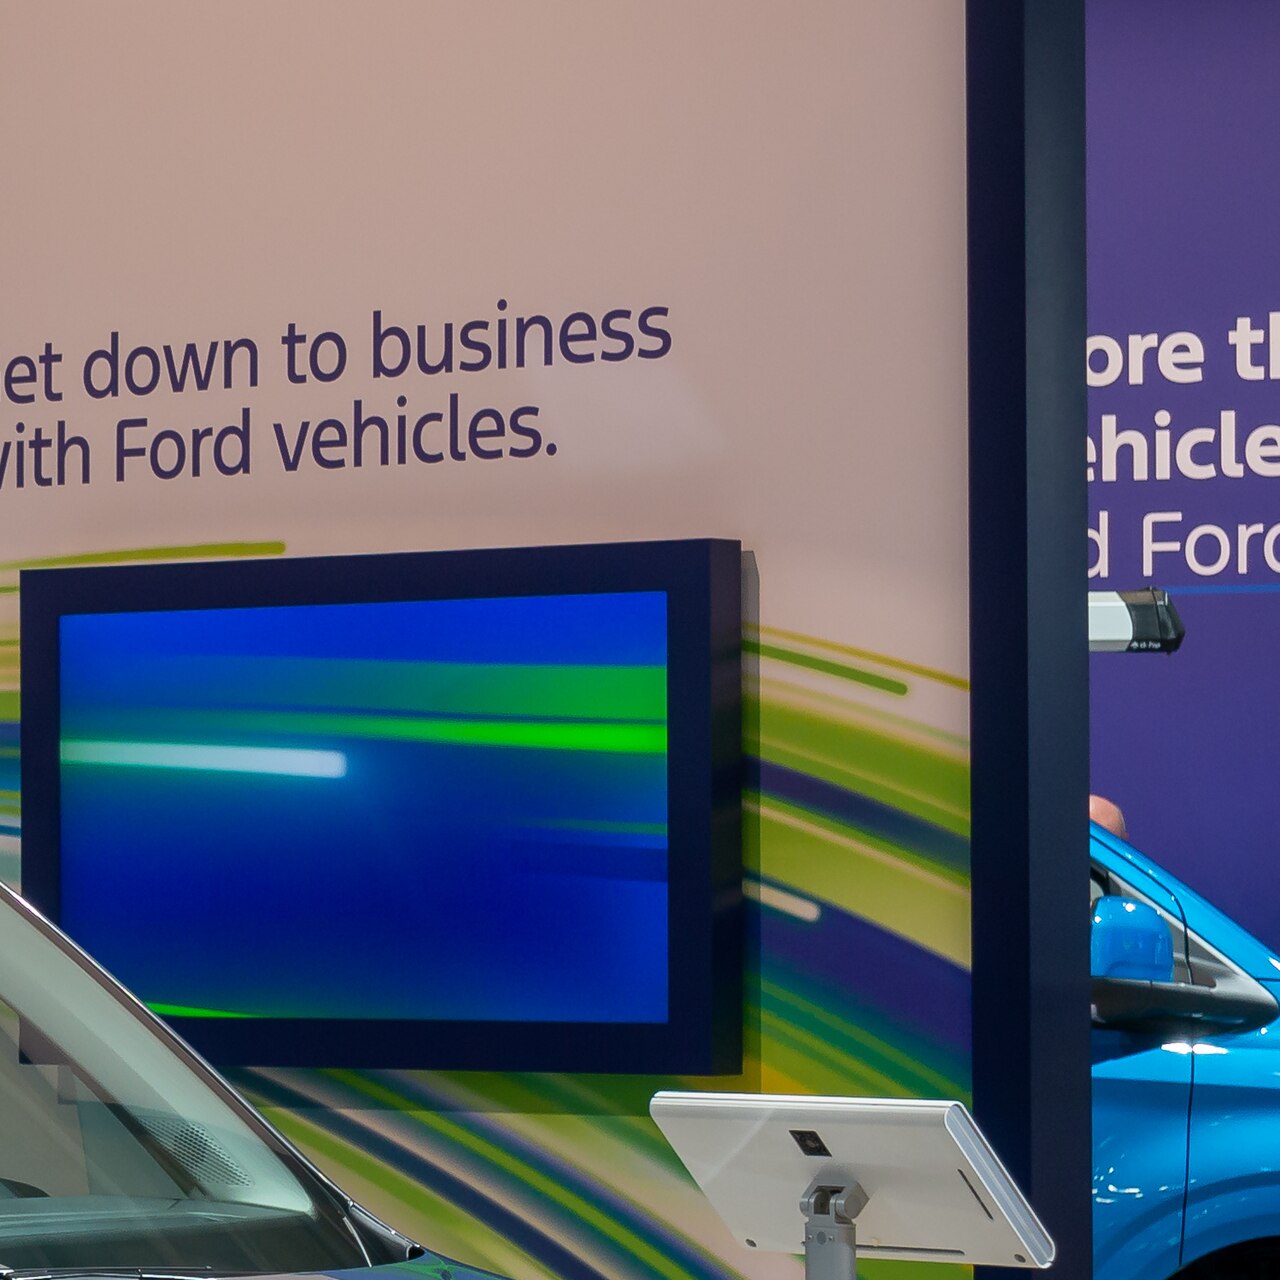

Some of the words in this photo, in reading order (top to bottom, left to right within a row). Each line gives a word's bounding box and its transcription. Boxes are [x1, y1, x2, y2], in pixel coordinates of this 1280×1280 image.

[81, 331, 260, 400] down
[280, 322, 348, 385] to
[371, 298, 673, 379] business
[1228, 311, 1280, 381] t
[115, 406, 252, 483] Ford
[272, 392, 559, 472] vehicles.
[1087, 408, 1280, 483] hicle
